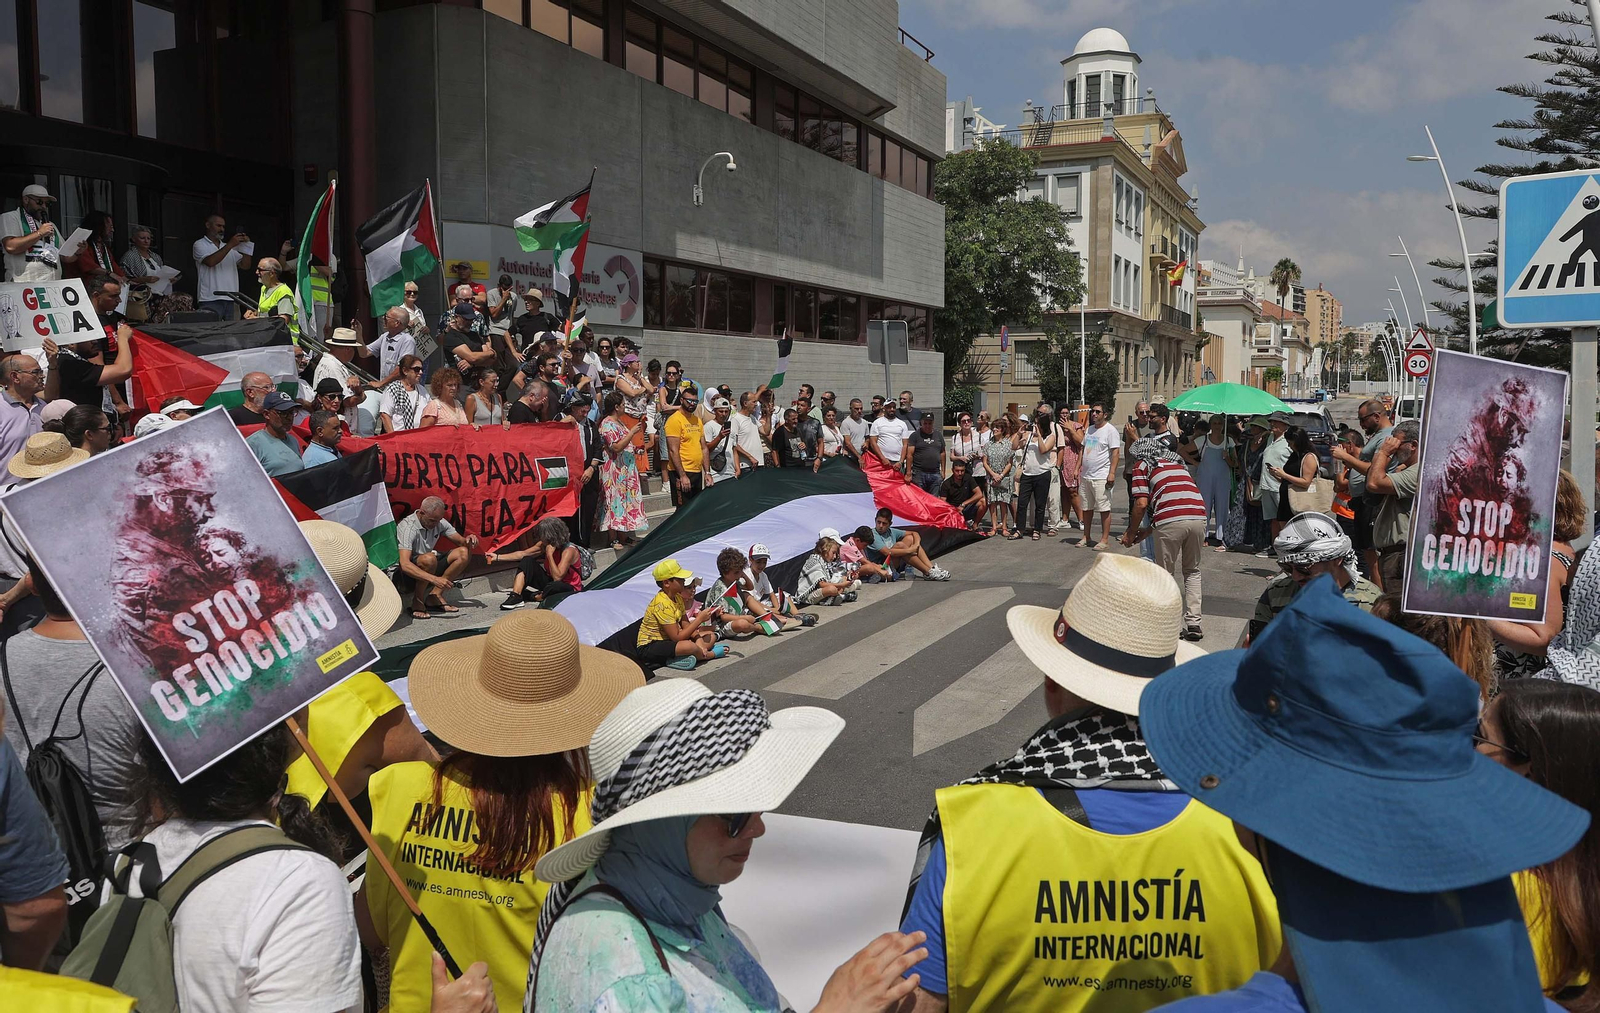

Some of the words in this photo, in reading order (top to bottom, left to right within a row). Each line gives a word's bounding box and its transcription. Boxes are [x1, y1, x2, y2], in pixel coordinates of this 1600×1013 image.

[23, 286, 80, 310] GENO
[33, 310, 94, 336] CIDA
[1410, 360, 1427, 368] 30
[380, 452, 463, 489] UERTO
[467, 452, 536, 487] PARA
[1457, 497, 1513, 538] STOP
[1421, 533, 1540, 580] GENOCIDIO
[172, 579, 263, 653] STOP
[150, 591, 338, 721] GENOCIDIO
[405, 877, 515, 908] www.es.amnesty.org
[1034, 868, 1206, 924] AMNISTÍA
[1034, 932, 1204, 962] INTERNACIONAL
[1043, 975, 1193, 992] www.es.amnesty.org
